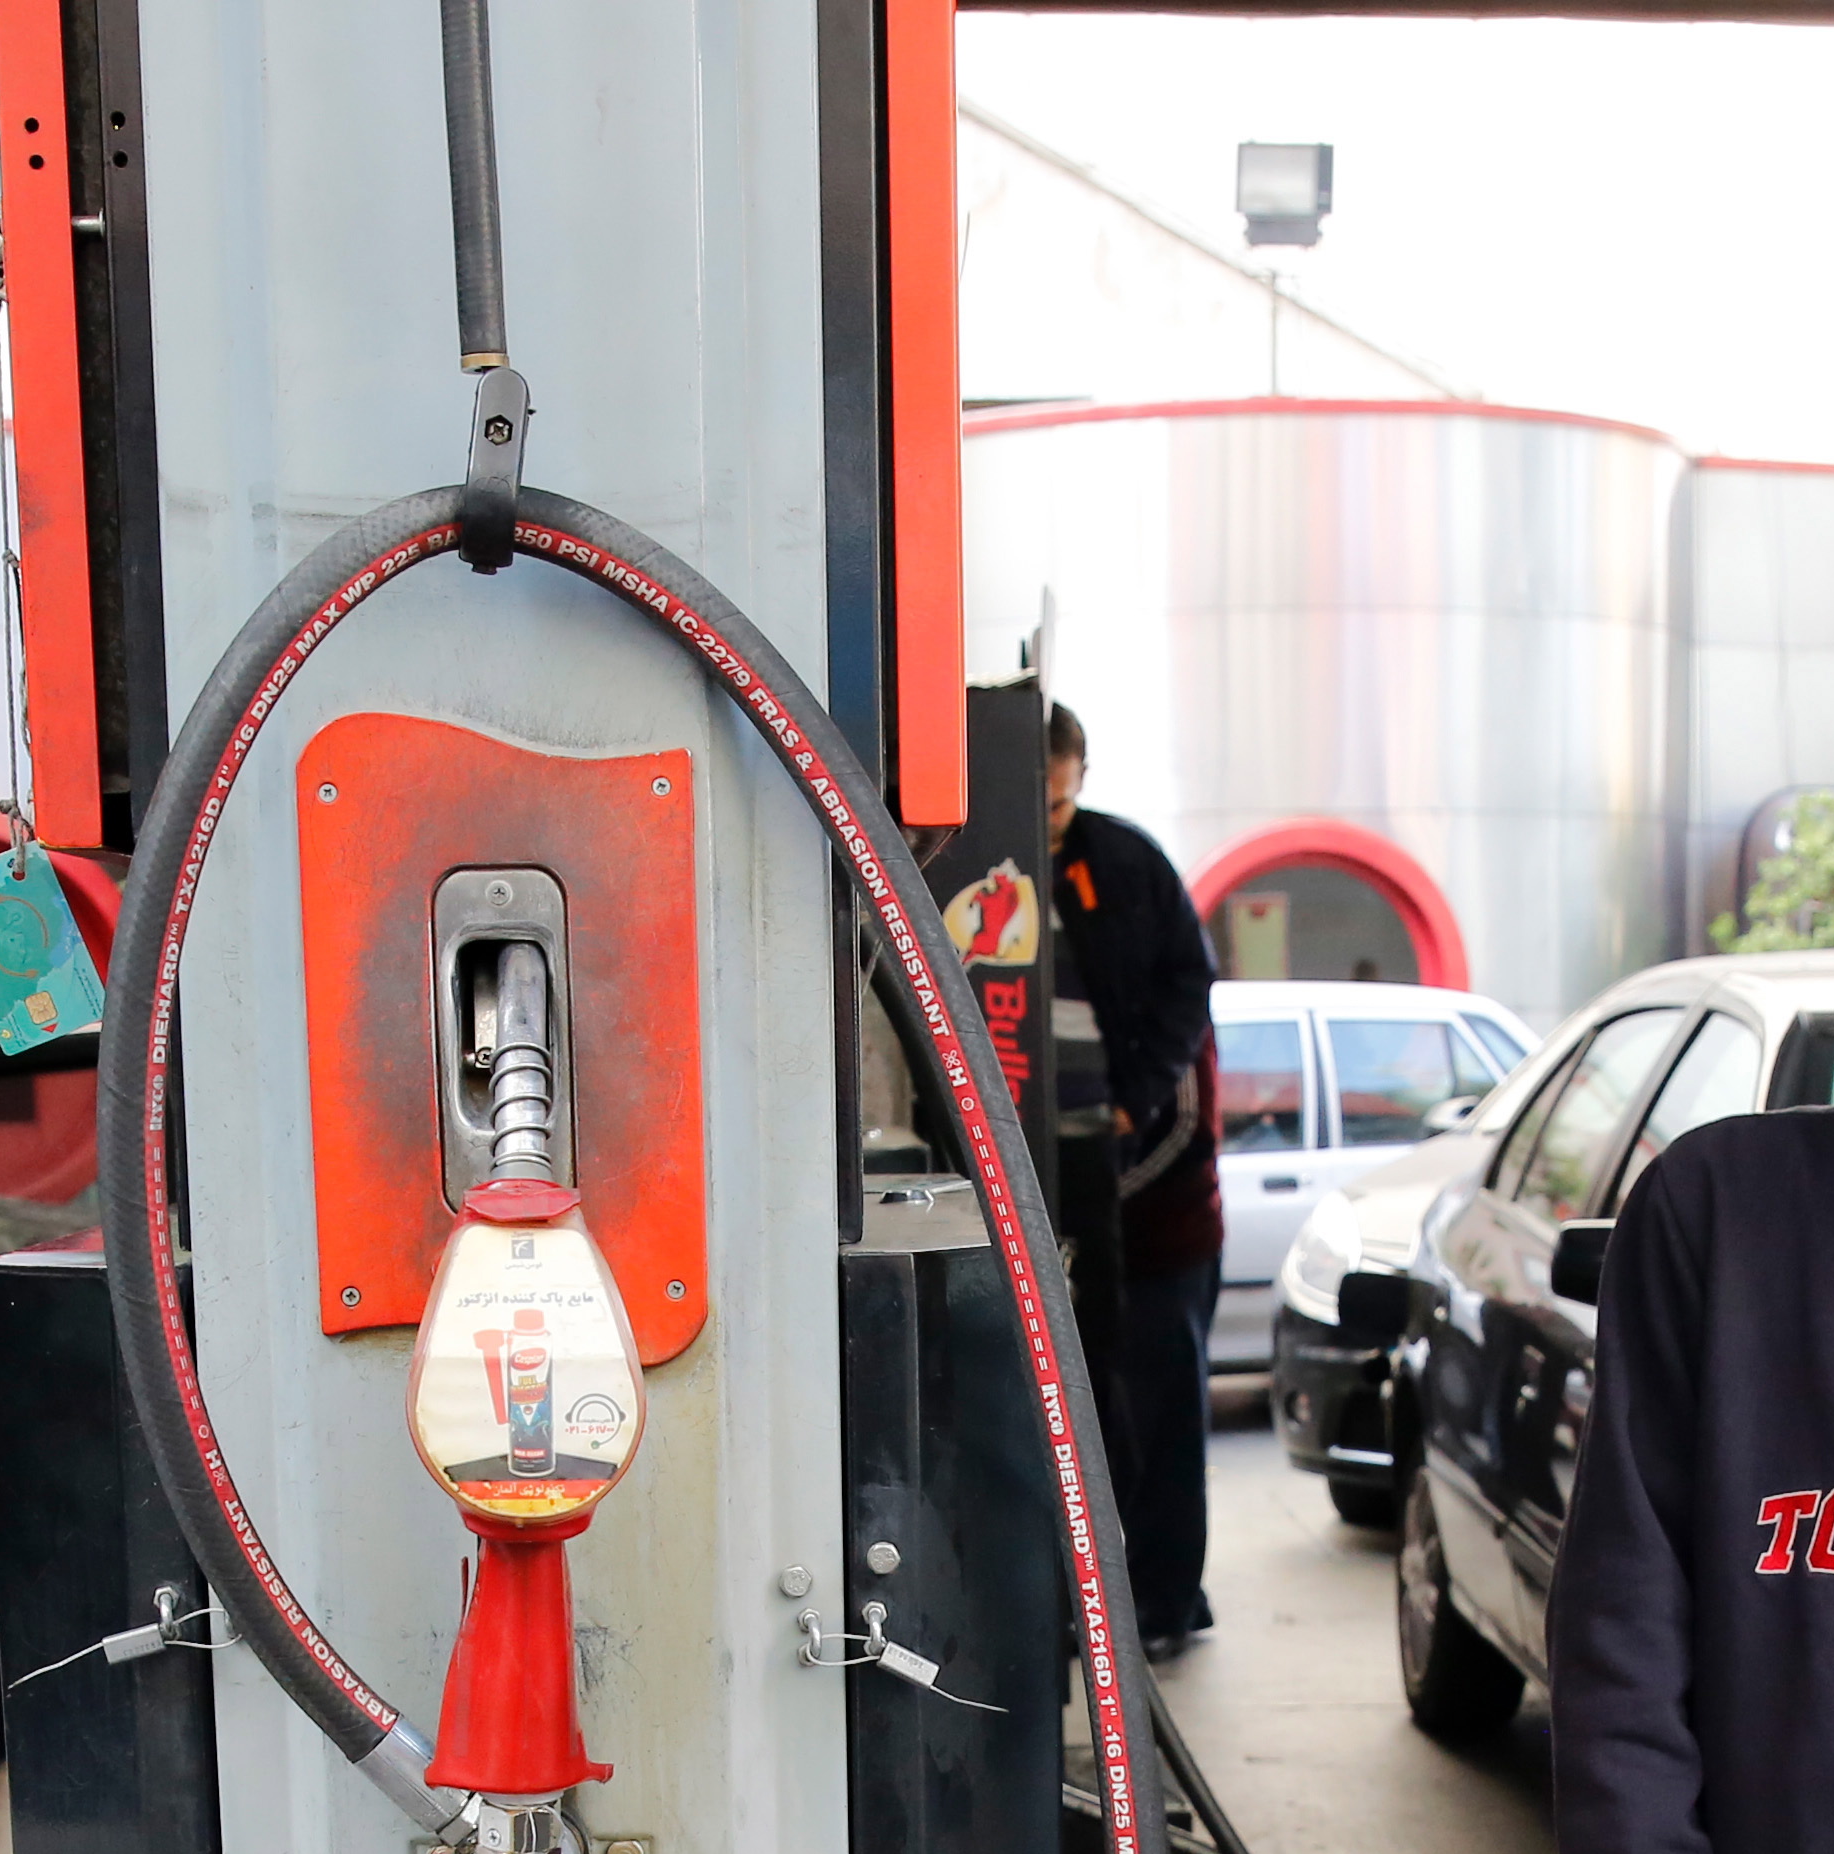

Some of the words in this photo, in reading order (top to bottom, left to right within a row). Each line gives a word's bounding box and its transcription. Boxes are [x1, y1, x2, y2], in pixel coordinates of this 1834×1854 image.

[174, 797, 221, 915] TXA216D
[251, 657, 297, 720] DN25
[295, 603, 341, 656] MAX
[341, 570, 377, 605] WP
[380, 544, 421, 577] 225
[427, 527, 459, 551] BA
[513, 526, 553, 551] 250
[558, 540, 599, 568] PSI
[601, 560, 668, 613] MSHA
[671, 608, 751, 689] IC-227/9
[748, 687, 800, 748] FRAS
[795, 752, 814, 772] &
[810, 778, 889, 899] ABRASION
[880, 901, 950, 1038] RESISTANT
[456, 1292, 499, 1308] انژکتور
[502, 1292, 537, 1304] کننده
[540, 1292, 564, 1307] پاک
[567, 1292, 595, 1307] مایع
[493, 1482, 516, 1497] آلمان
[225, 1500, 307, 1625] RESISTANT
[1040, 1382, 1065, 1436] RYCO
[1082, 1576, 1112, 1688] TXA216D
[1109, 1765, 1131, 1829] DN25
[298, 1624, 398, 1727] ABRASION
